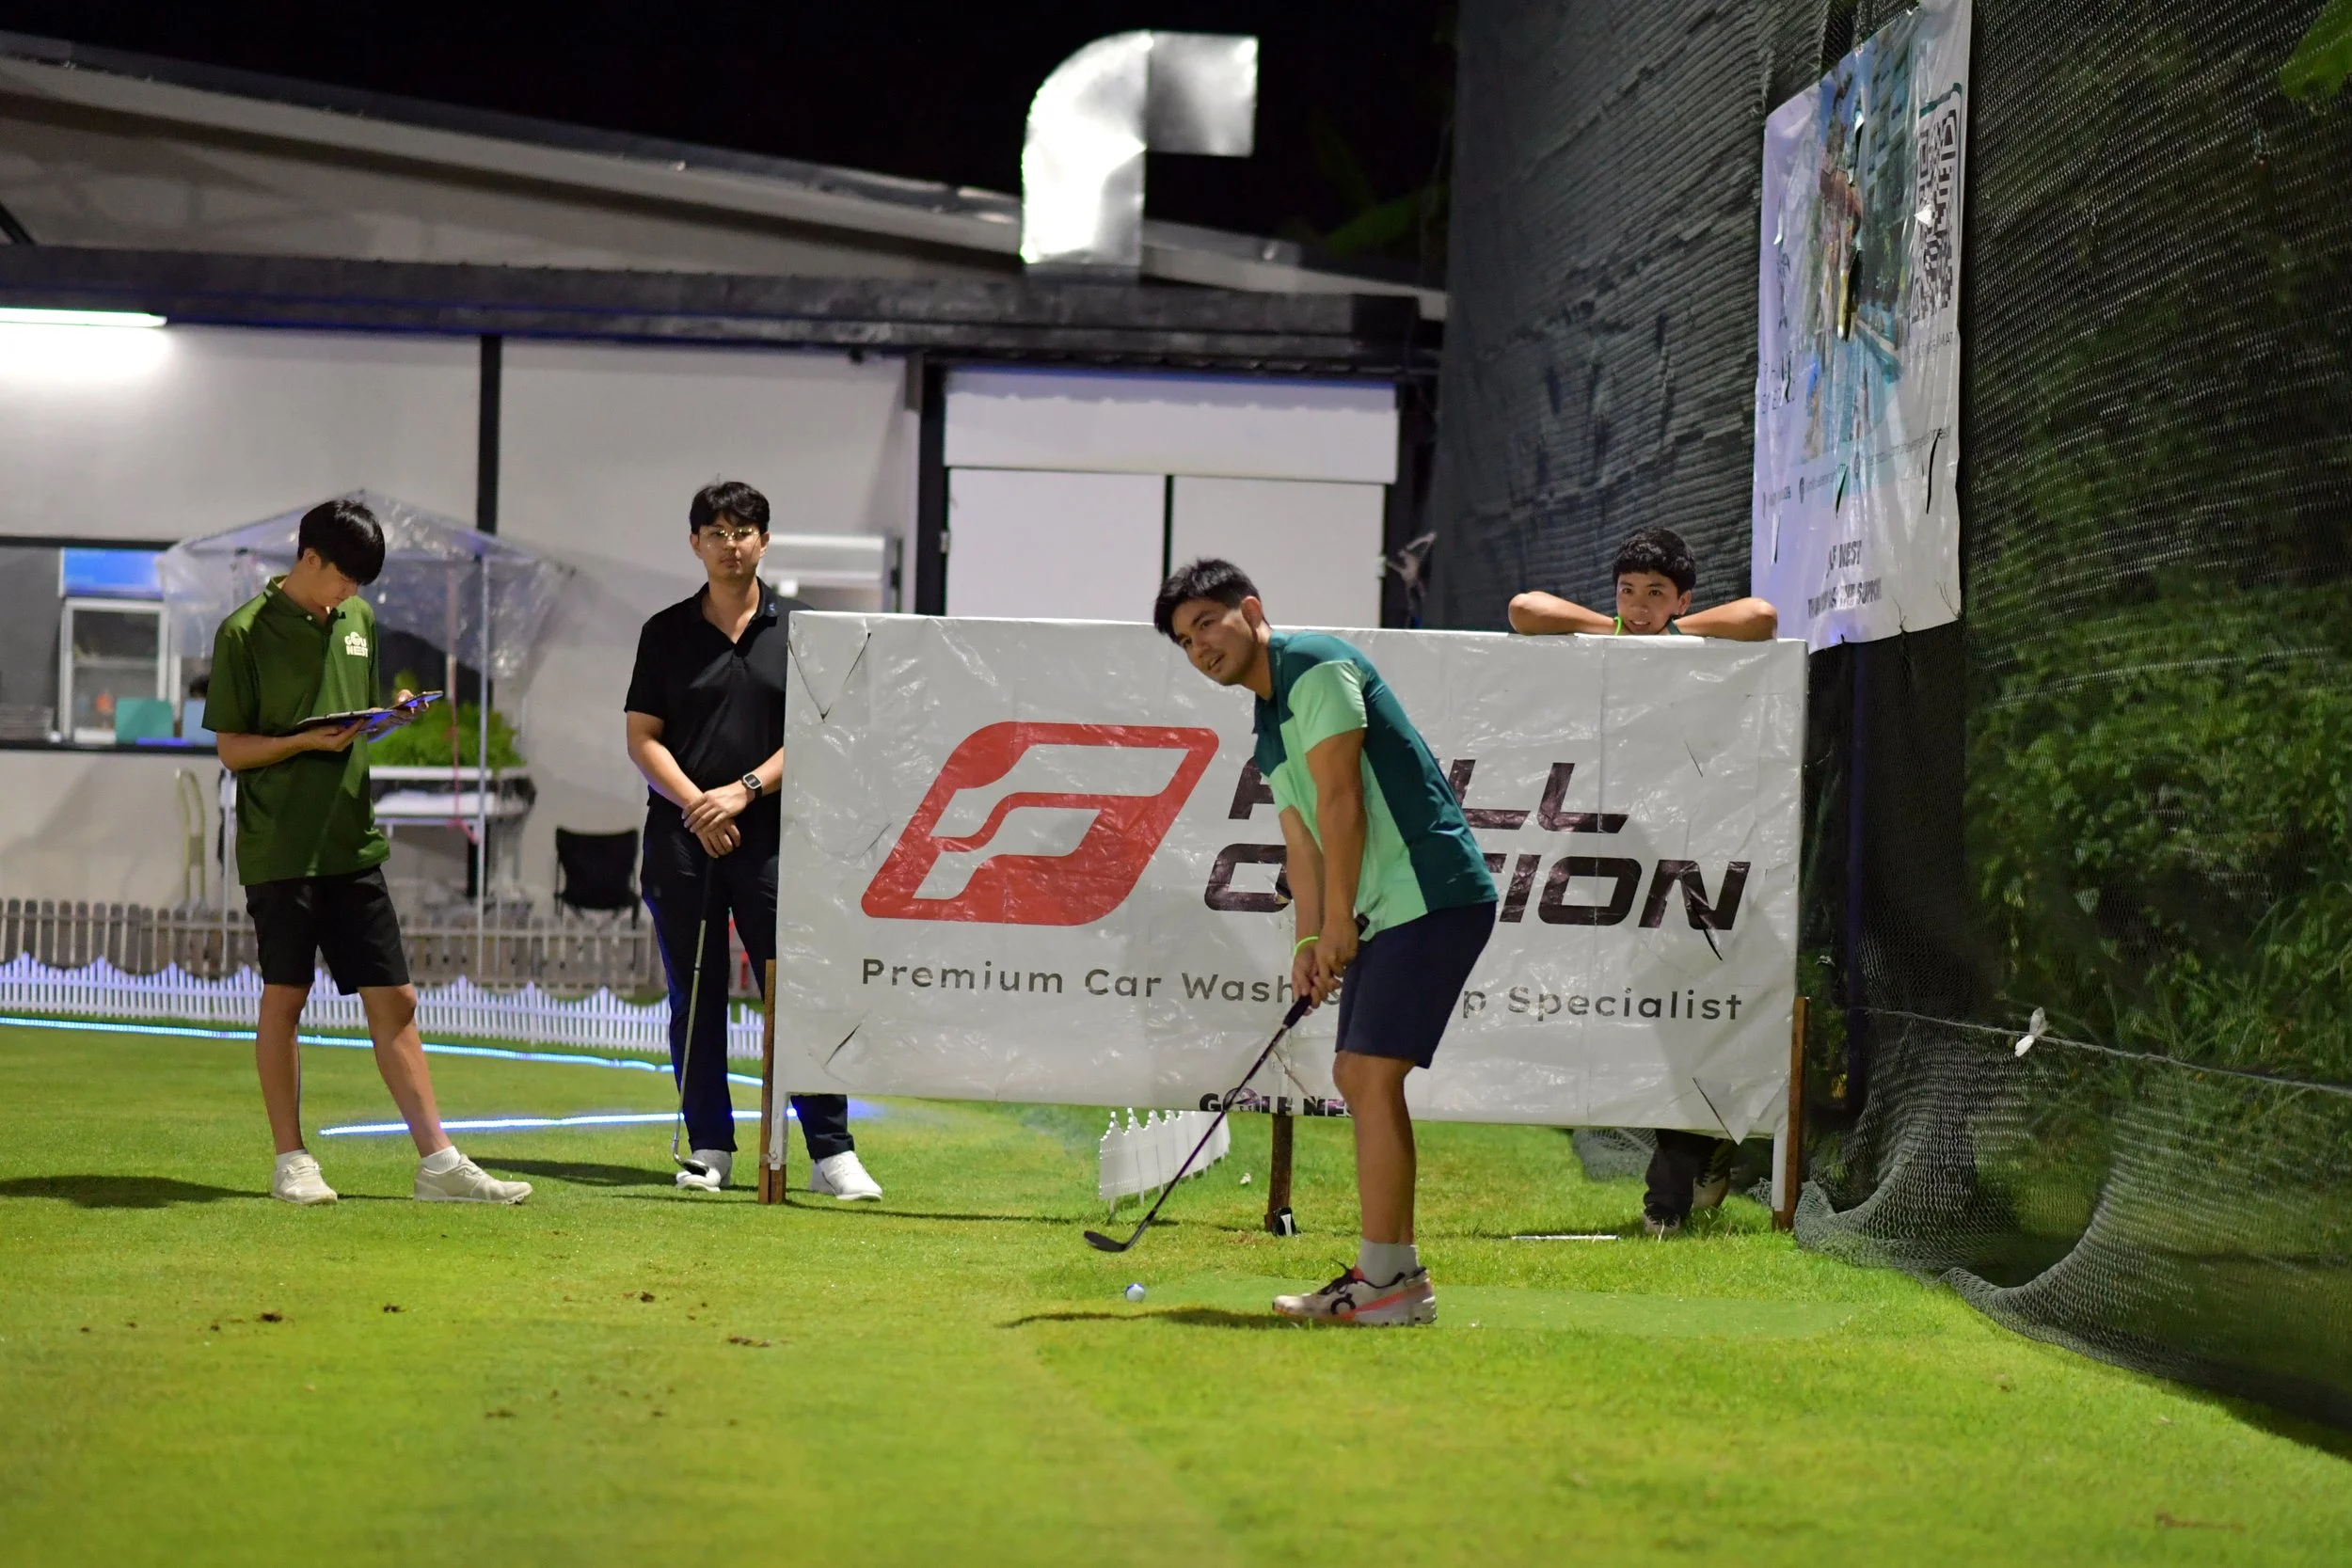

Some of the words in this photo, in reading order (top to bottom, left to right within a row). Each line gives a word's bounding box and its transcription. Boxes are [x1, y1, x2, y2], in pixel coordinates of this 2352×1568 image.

[1228, 756, 1629, 834] FLL
[1204, 843, 1752, 931] OION
[862, 958, 1063, 993] Premium
[1085, 968, 1163, 997] Car
[1182, 972, 1295, 1004] Wash
[1507, 986, 1742, 1022] Specialist
